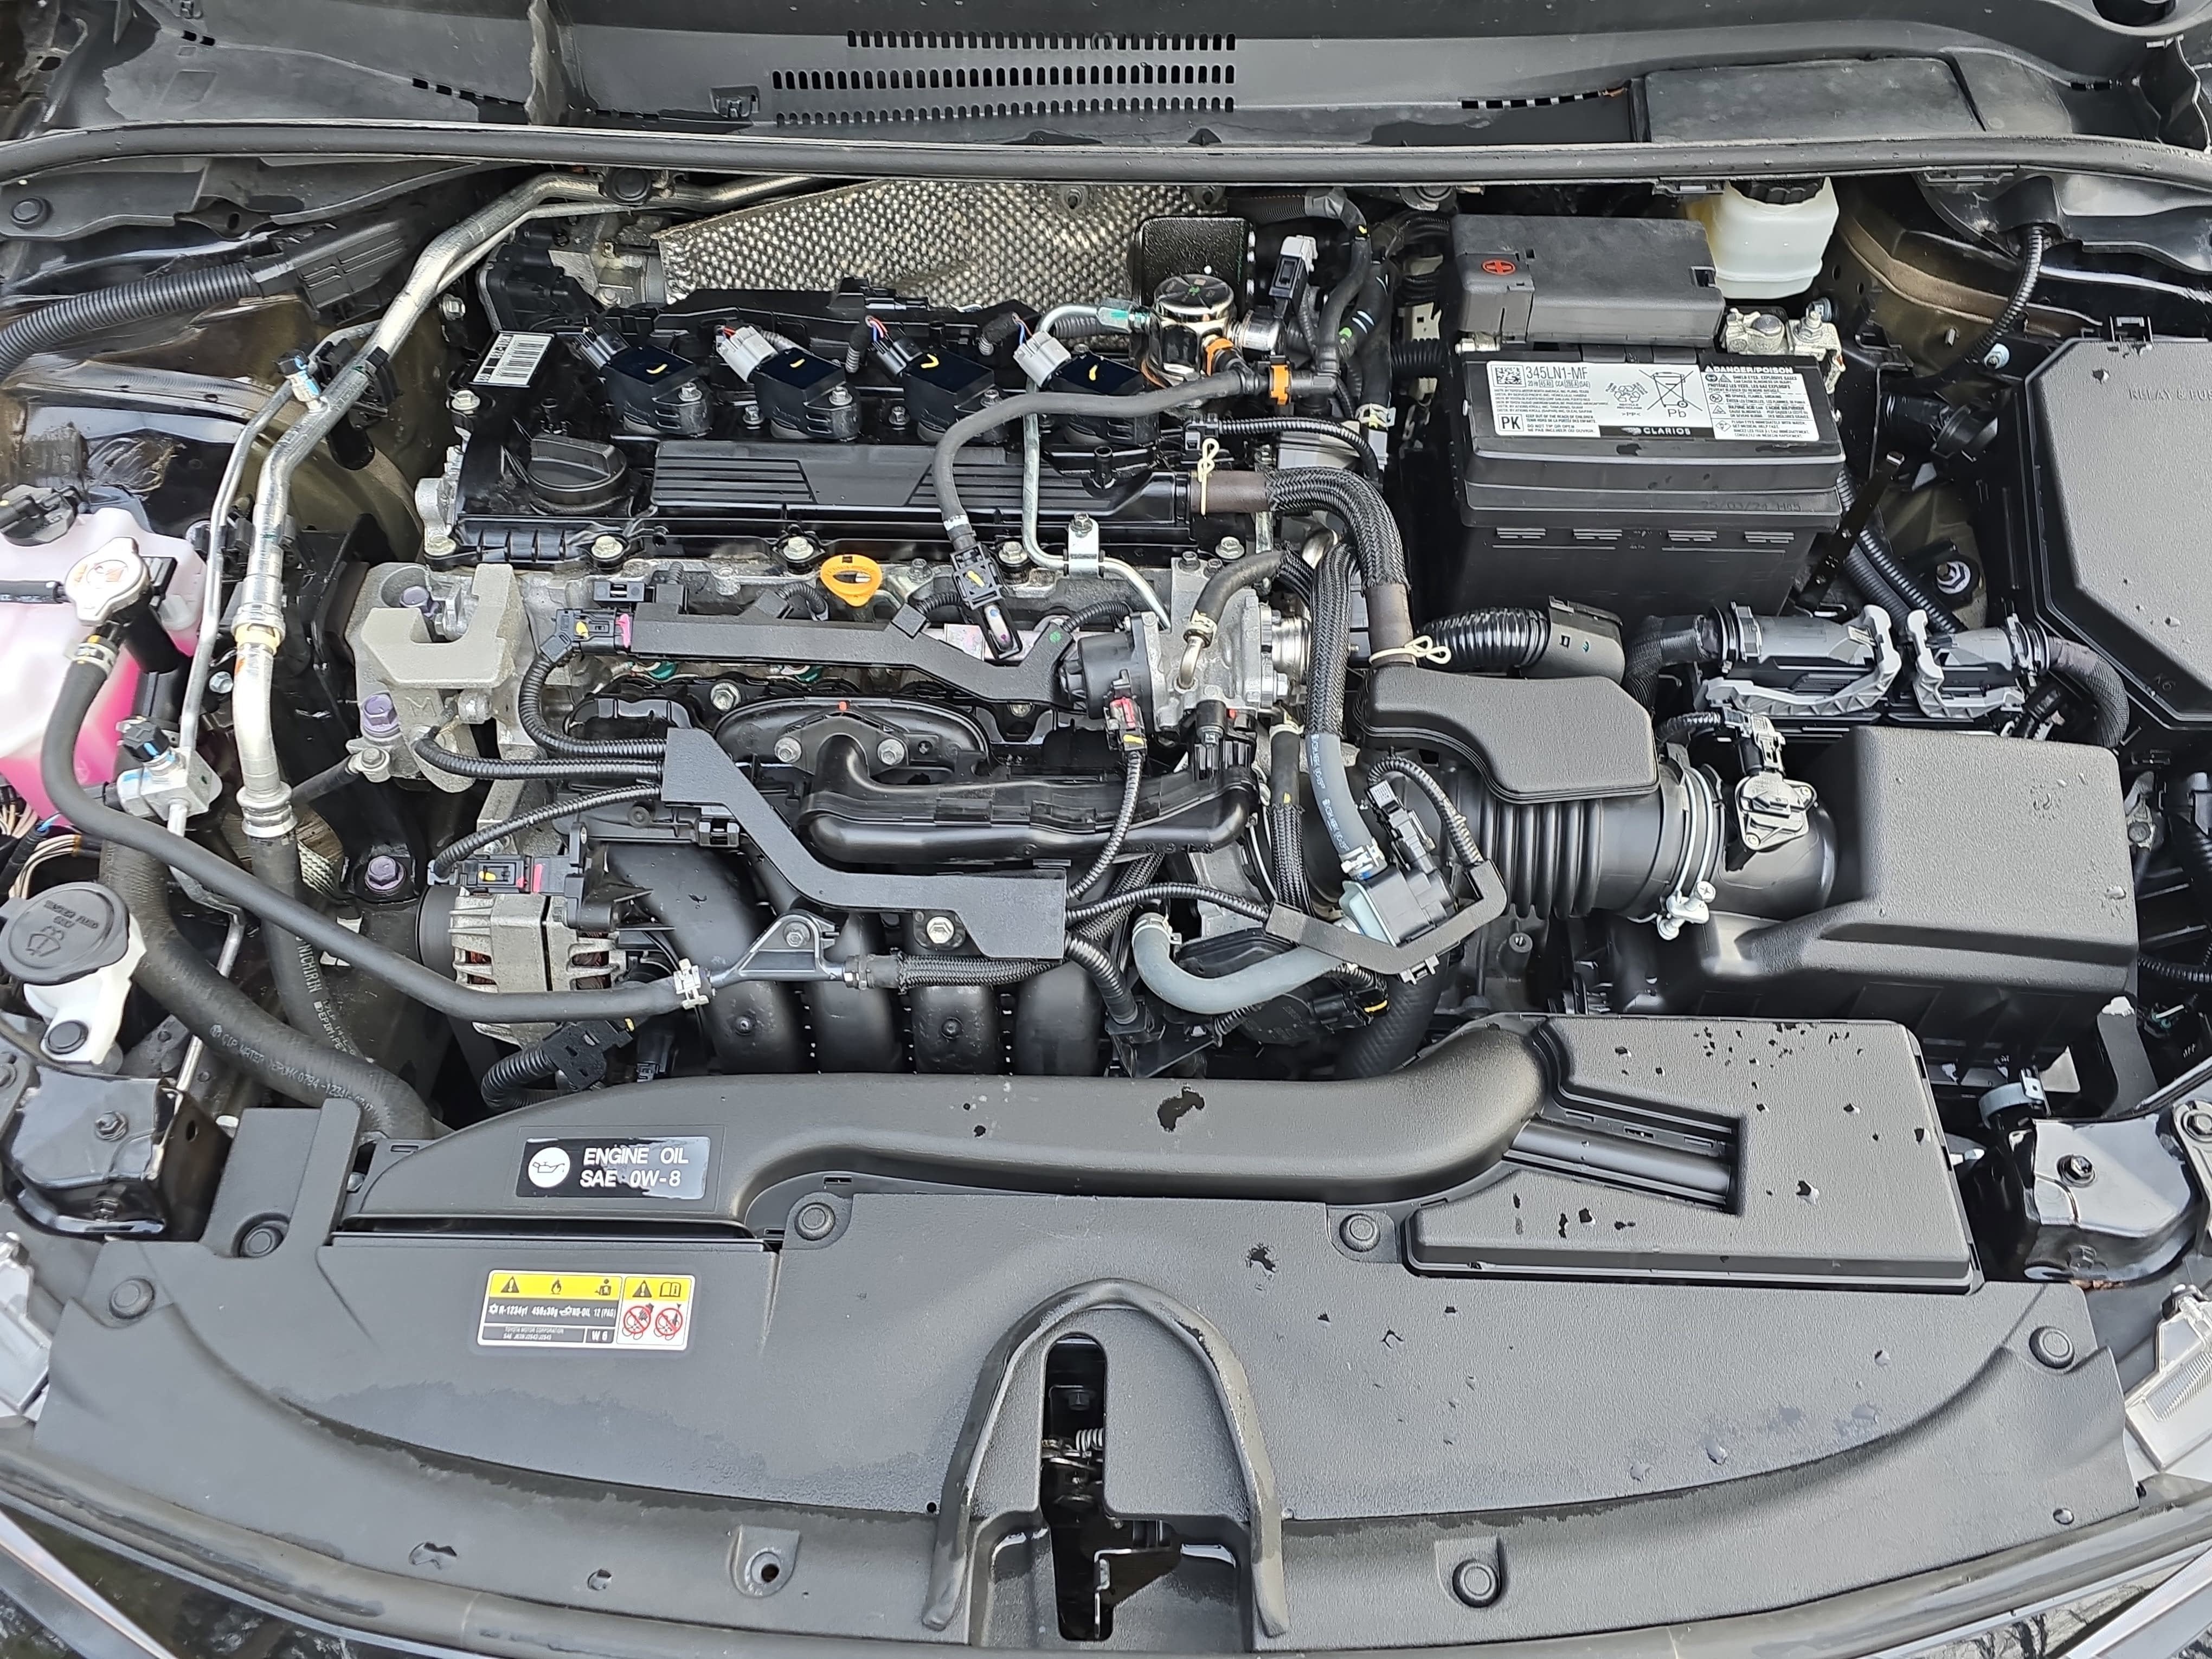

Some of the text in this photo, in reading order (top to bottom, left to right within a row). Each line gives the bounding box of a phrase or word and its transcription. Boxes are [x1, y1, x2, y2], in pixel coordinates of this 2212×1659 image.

[1526, 366, 1588, 380] 345LN1-MF
[1667, 409, 1687, 418] Pb
[1501, 416, 1521, 429] PK
[1643, 427, 1691, 435] CLARIOS
[297, 943, 323, 993] NICHIRIN
[583, 1147, 689, 1166] ENGINE OIL
[580, 1169, 681, 1188] SAE 0W-8
[593, 1308, 601, 1317] 12
[591, 1330, 608, 1341] W 6
